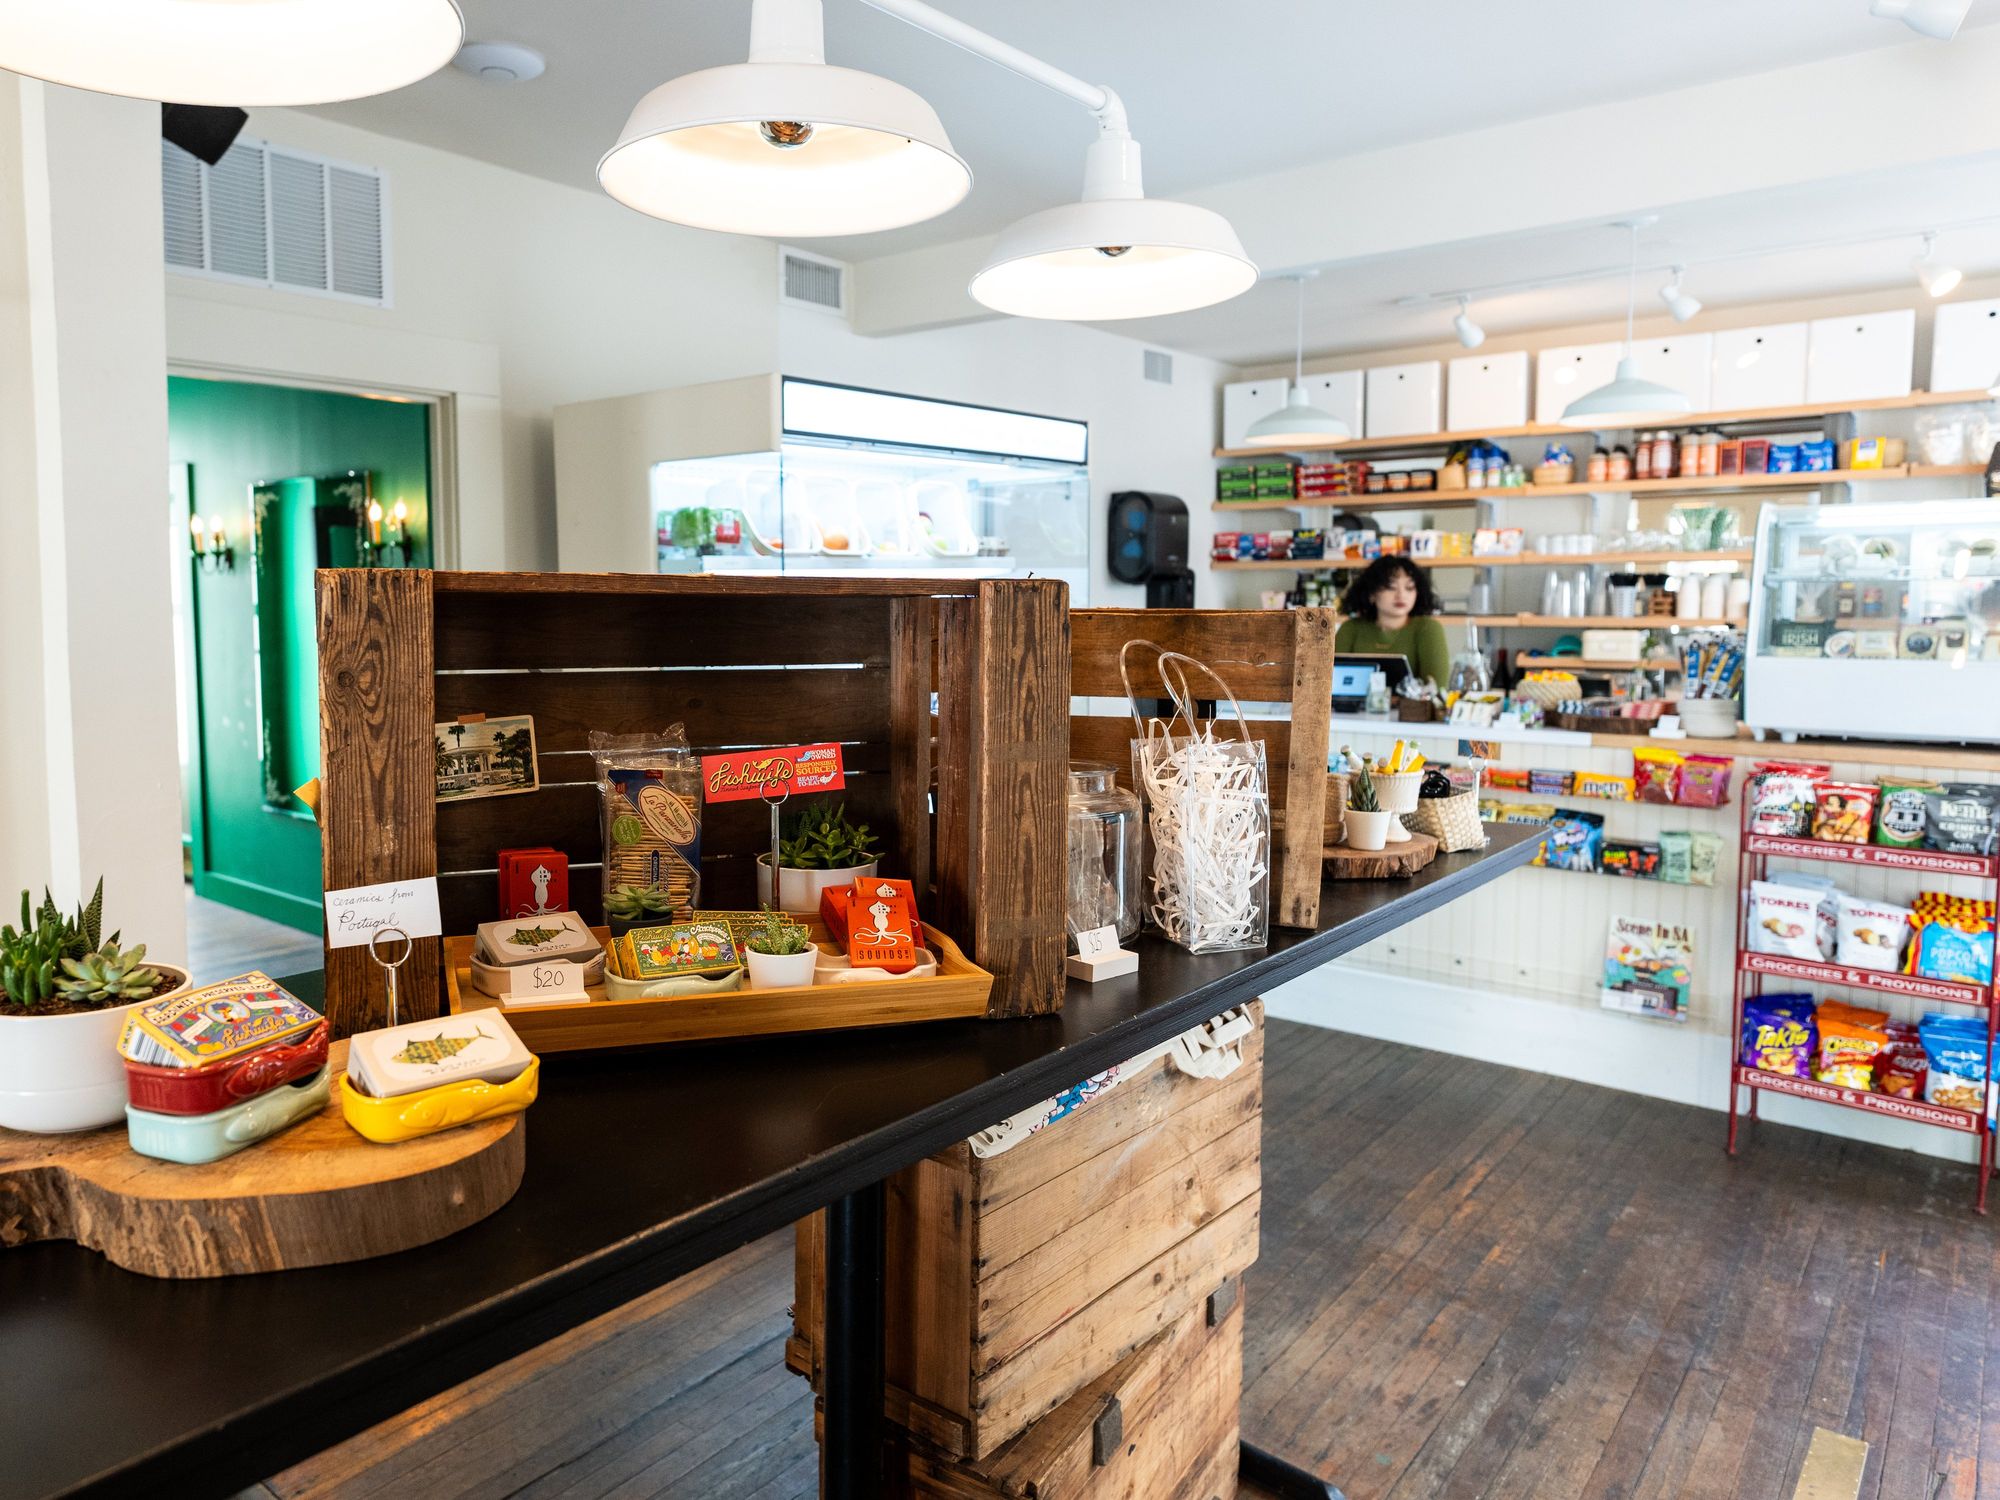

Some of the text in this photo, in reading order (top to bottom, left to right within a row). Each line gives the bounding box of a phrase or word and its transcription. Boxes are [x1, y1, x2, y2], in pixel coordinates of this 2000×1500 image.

[1782, 632, 1819, 644] IRISH
[795, 760, 837, 770] RESPONSIBLY
[796, 765, 838, 776] SOURCED
[710, 757, 793, 793] Fishwife
[1508, 816, 1550, 827] HARIBO
[1939, 822, 1990, 835] KRINKLE
[1754, 839, 1981, 872] GROCERIES & PROVISIONS
[389, 888, 413, 904] from
[1759, 896, 1809, 911] TORRES
[1850, 908, 1900, 922] TORRES
[338, 910, 400, 937] Portugal
[1617, 918, 1652, 936] Scene
[1656, 923, 1669, 939] In
[859, 949, 903, 960] SQUIDS
[533, 966, 564, 988] $20
[1751, 957, 1973, 999] GROCERIES & PROVISIONS
[1755, 1022, 1809, 1050] Takis
[1748, 1072, 1967, 1125] GROCERIES & PROVISIONS
